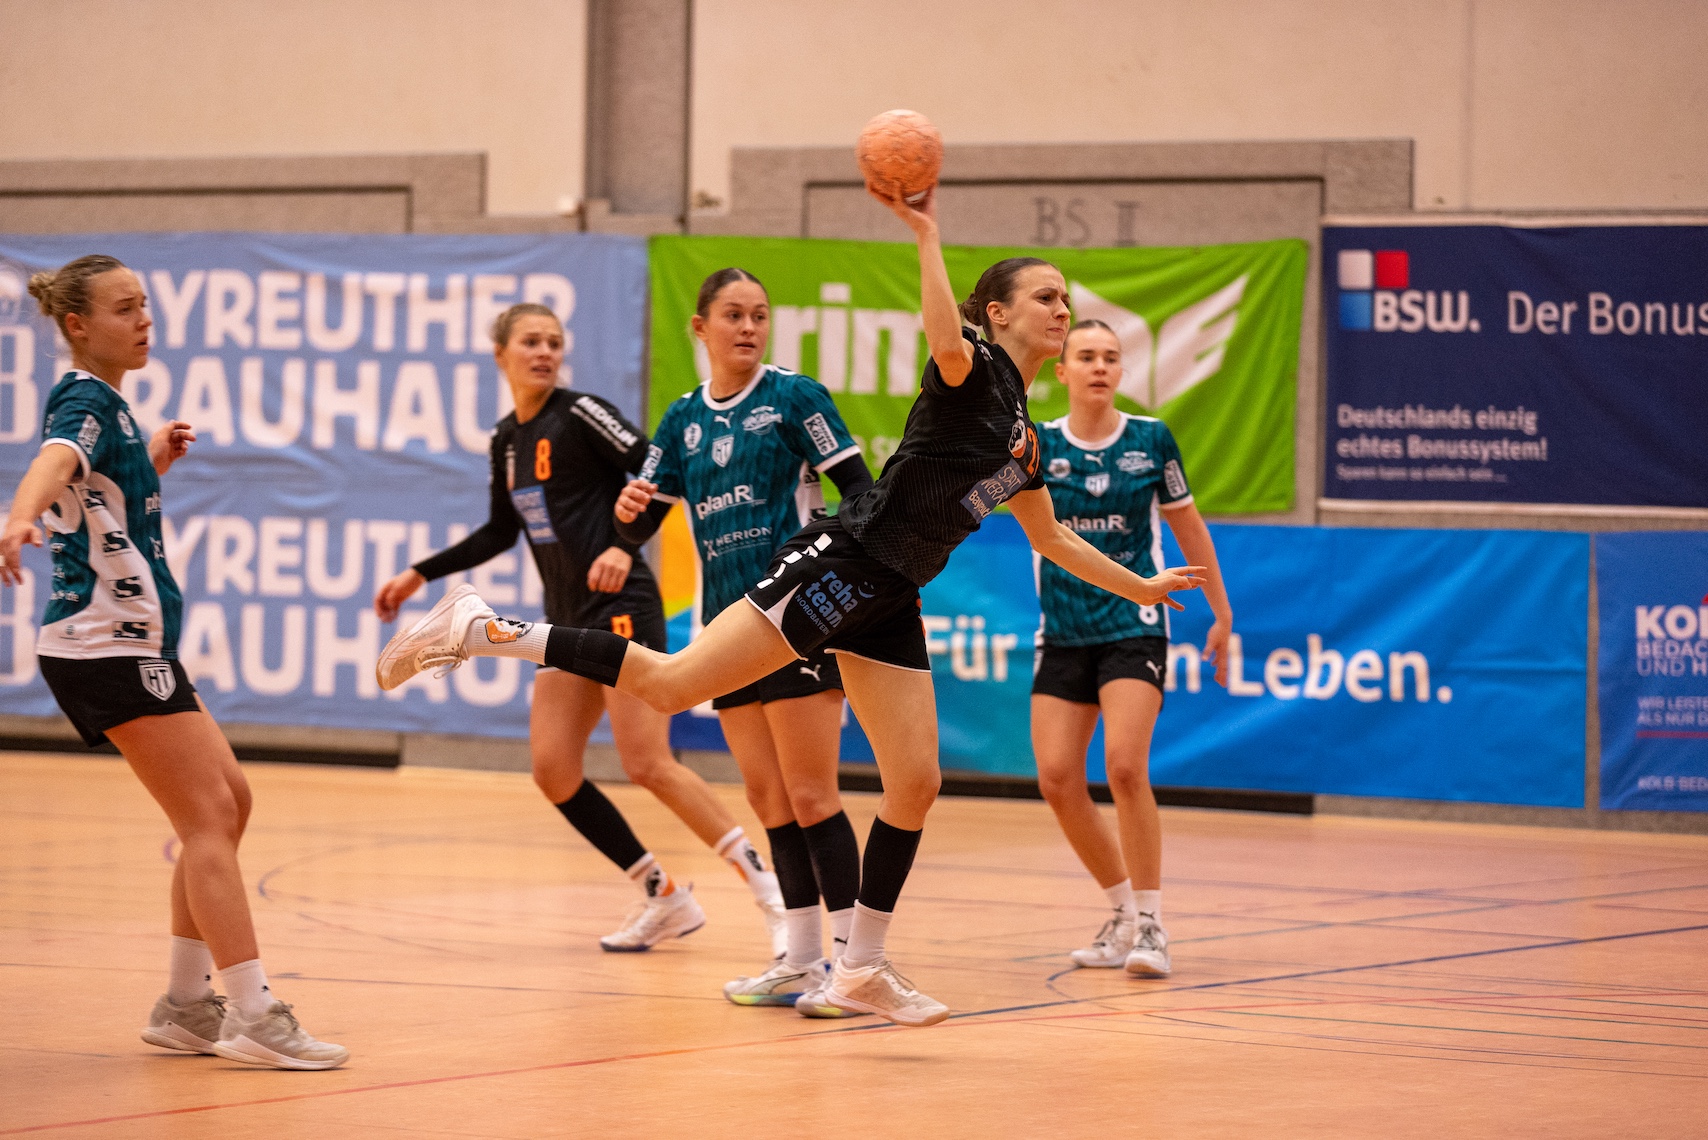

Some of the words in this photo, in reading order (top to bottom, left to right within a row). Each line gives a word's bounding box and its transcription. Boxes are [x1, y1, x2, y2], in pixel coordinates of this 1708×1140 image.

[55, 268, 576, 354] YREUTHER
[1373, 290, 1481, 334] BSW.
[1507, 290, 1578, 335] Der
[55, 357, 573, 453] RAUHAU
[575, 396, 639, 448] MEDICLIN
[1336, 403, 1473, 429] Deutschlands
[1475, 404, 1538, 435] einzig
[534, 438, 552, 481] 8
[1026, 426, 1041, 479] 2
[1336, 433, 1404, 459] echtes
[1407, 433, 1548, 464] Bonussystem!
[163, 515, 546, 608] YREUTHE
[805, 582, 843, 628] team
[821, 570, 858, 613] reha
[795, 594, 831, 636] NORDBAYERN
[1228, 633, 1453, 703] Leben.
[1636, 639, 1708, 659] BEDAC
[1636, 657, 1686, 677] UND
[1691, 657, 1708, 677] H
[1667, 696, 1708, 712] LEISTE
[1697, 711, 1708, 727] D
[1678, 776, 1708, 791] BED
